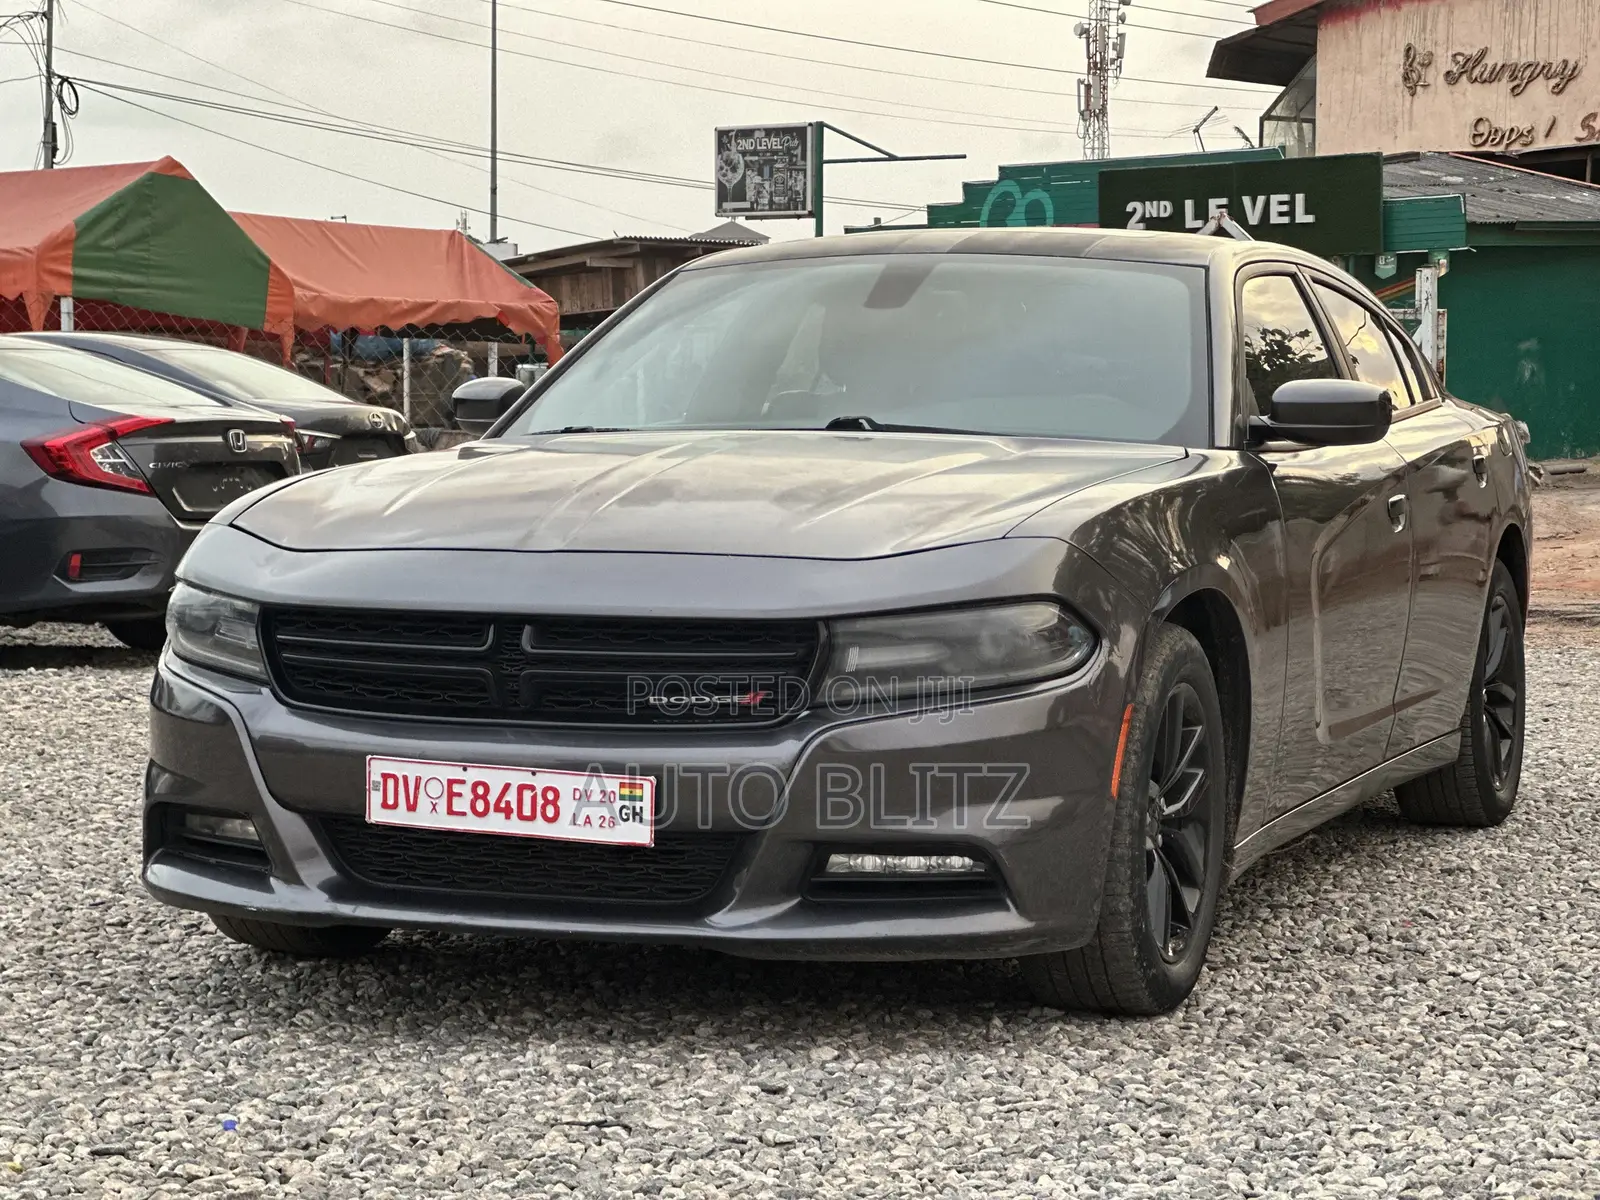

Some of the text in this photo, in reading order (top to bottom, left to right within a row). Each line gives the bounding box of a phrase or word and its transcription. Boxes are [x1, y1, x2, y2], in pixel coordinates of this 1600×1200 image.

[1443, 46, 1580, 96] Hungry
[1469, 116, 1534, 149] Oops
[1574, 111, 1600, 143] S
[737, 135, 799, 152] 2ND LEVEL Pub
[1125, 200, 1173, 230] 2ND
[380, 772, 422, 812] DV
[446, 778, 560, 824] E8408
[599, 790, 617, 804] 20
[598, 816, 616, 829] 26
[618, 804, 644, 824] GH
